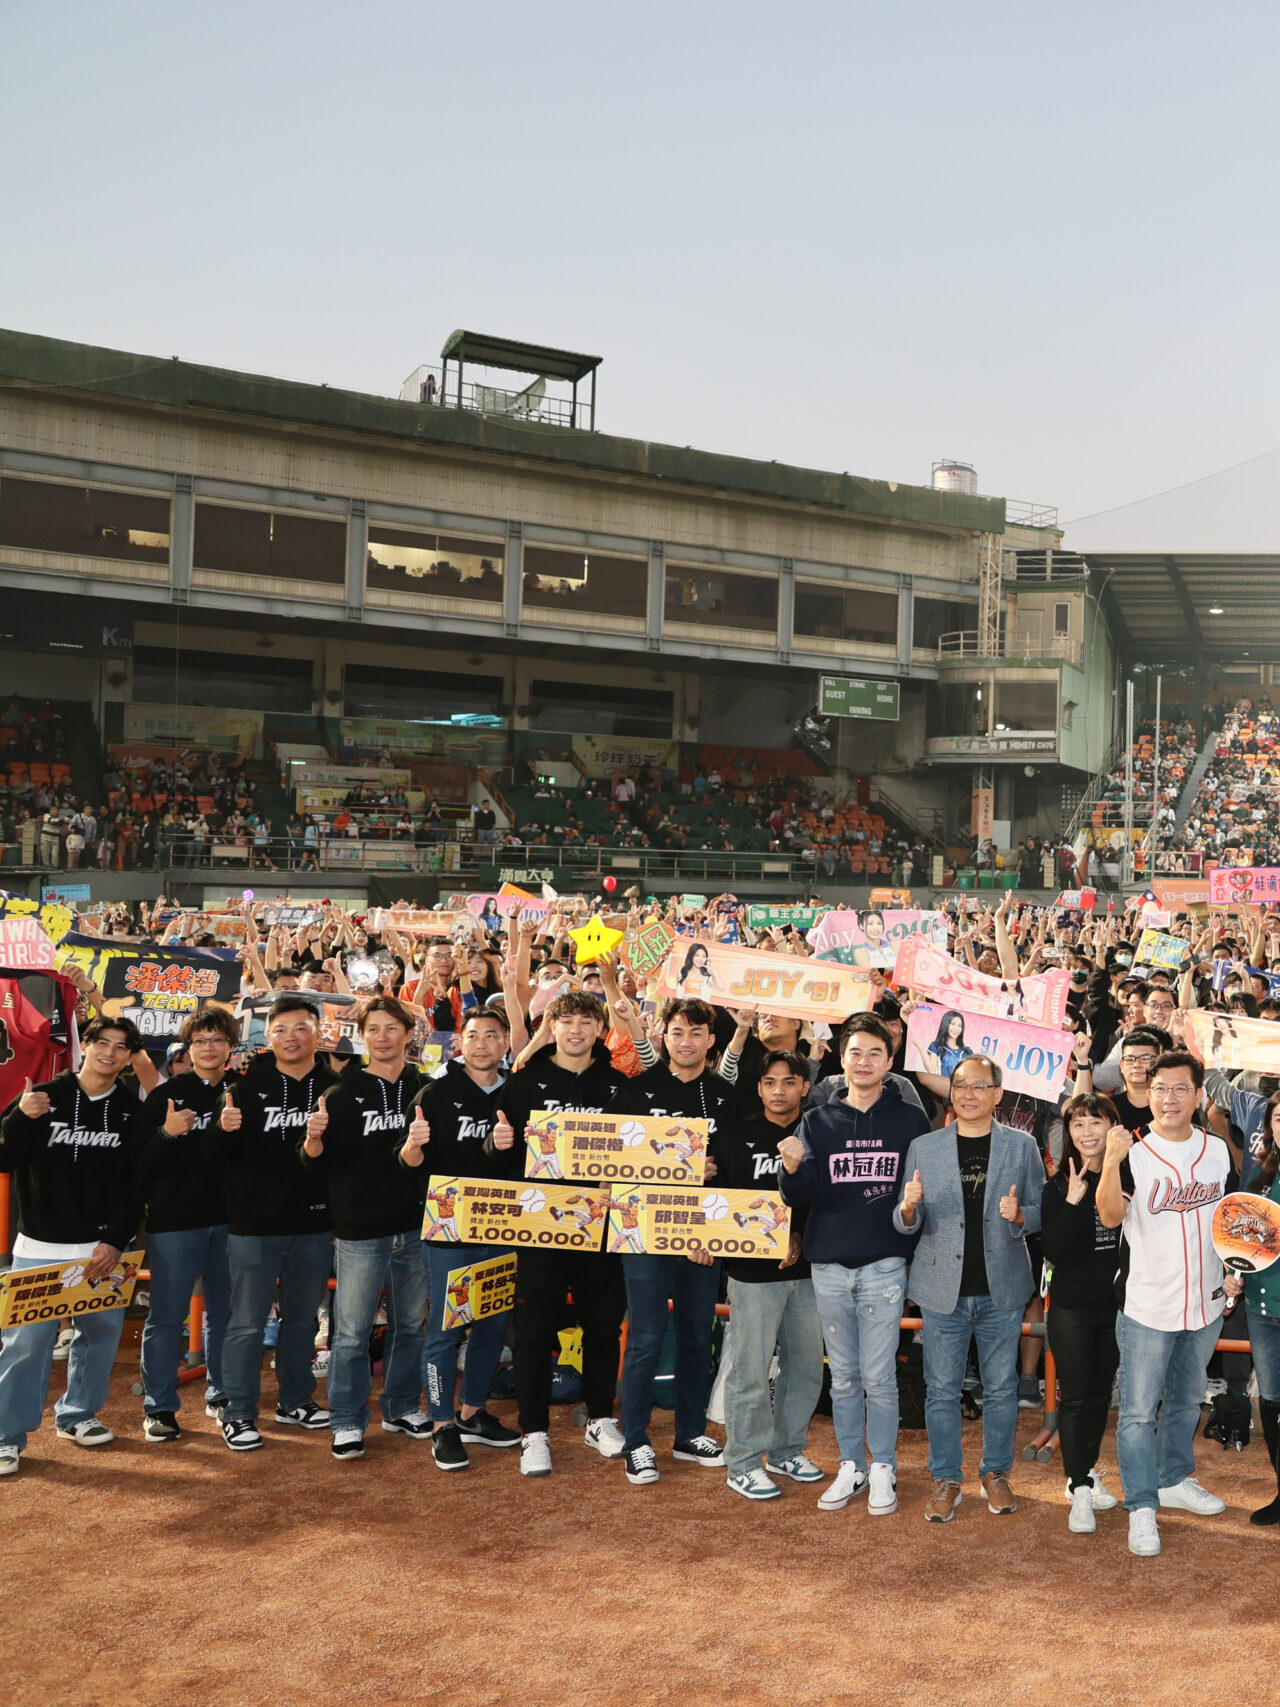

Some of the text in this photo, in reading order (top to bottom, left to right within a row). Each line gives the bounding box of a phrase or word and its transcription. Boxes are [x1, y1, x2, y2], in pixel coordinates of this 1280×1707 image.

[825, 689, 846, 699] GUEST
[876, 694, 894, 704] HOME
[849, 705, 872, 715] INNING
[391, 912, 438, 925] YUKI
[819, 928, 857, 953] Joy
[125, 962, 220, 997] 潘傑楷
[732, 969, 804, 998] JOY
[142, 993, 198, 1011] TEAM
[981, 1036, 1064, 1081] 91 JOY
[48, 1121, 121, 1148] Taiwan
[564, 1120, 617, 1134] 臺灣英雄
[571, 1136, 624, 1152] 潘傑楷
[571, 1162, 687, 1181] 1,000,000
[833, 1156, 897, 1178] 林冠維
[463, 1186, 517, 1200] 臺灣英雄
[646, 1193, 699, 1207] 臺灣英雄
[470, 1201, 523, 1217] 林安可
[654, 1210, 706, 1225] 邱智呈
[468, 1226, 585, 1247] 1,000,000
[654, 1236, 756, 1254] 300,000
[9, 1270, 60, 1288] 臺灣英雄
[474, 1261, 515, 1282] 臺灣英雄
[481, 1274, 518, 1293] 林岳平
[8, 1295, 118, 1325] 1,000,000
[479, 1295, 515, 1315] 500
[427, 1362, 440, 1407] PARIS
